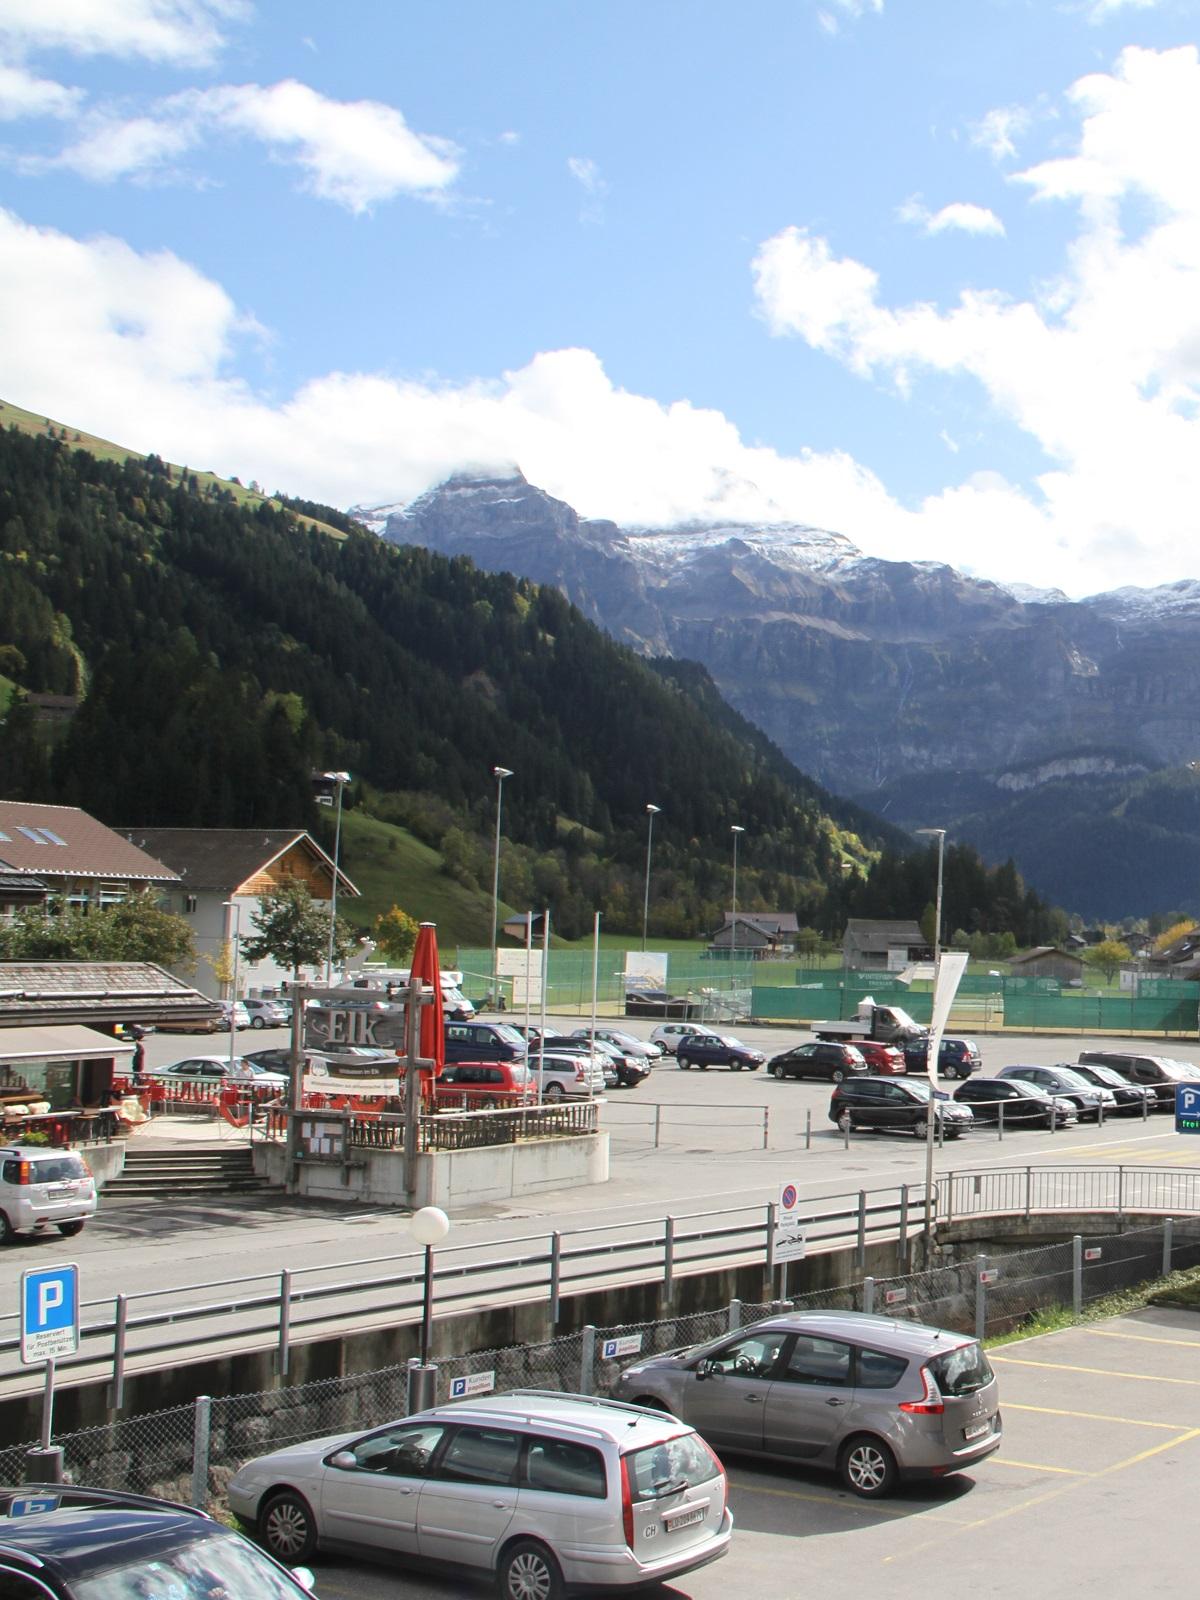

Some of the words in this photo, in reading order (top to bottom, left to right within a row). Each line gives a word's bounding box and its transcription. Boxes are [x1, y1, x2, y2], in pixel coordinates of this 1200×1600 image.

[325, 1010, 380, 1046] Elk
[1184, 1093, 1195, 1109] P
[1182, 1119, 1200, 1128] frei
[39, 1280, 63, 1325] P
[36, 1329, 65, 1339] Reserviert
[608, 1343, 615, 1354] P
[456, 1382, 464, 1393] P
[645, 1525, 656, 1538] CH
